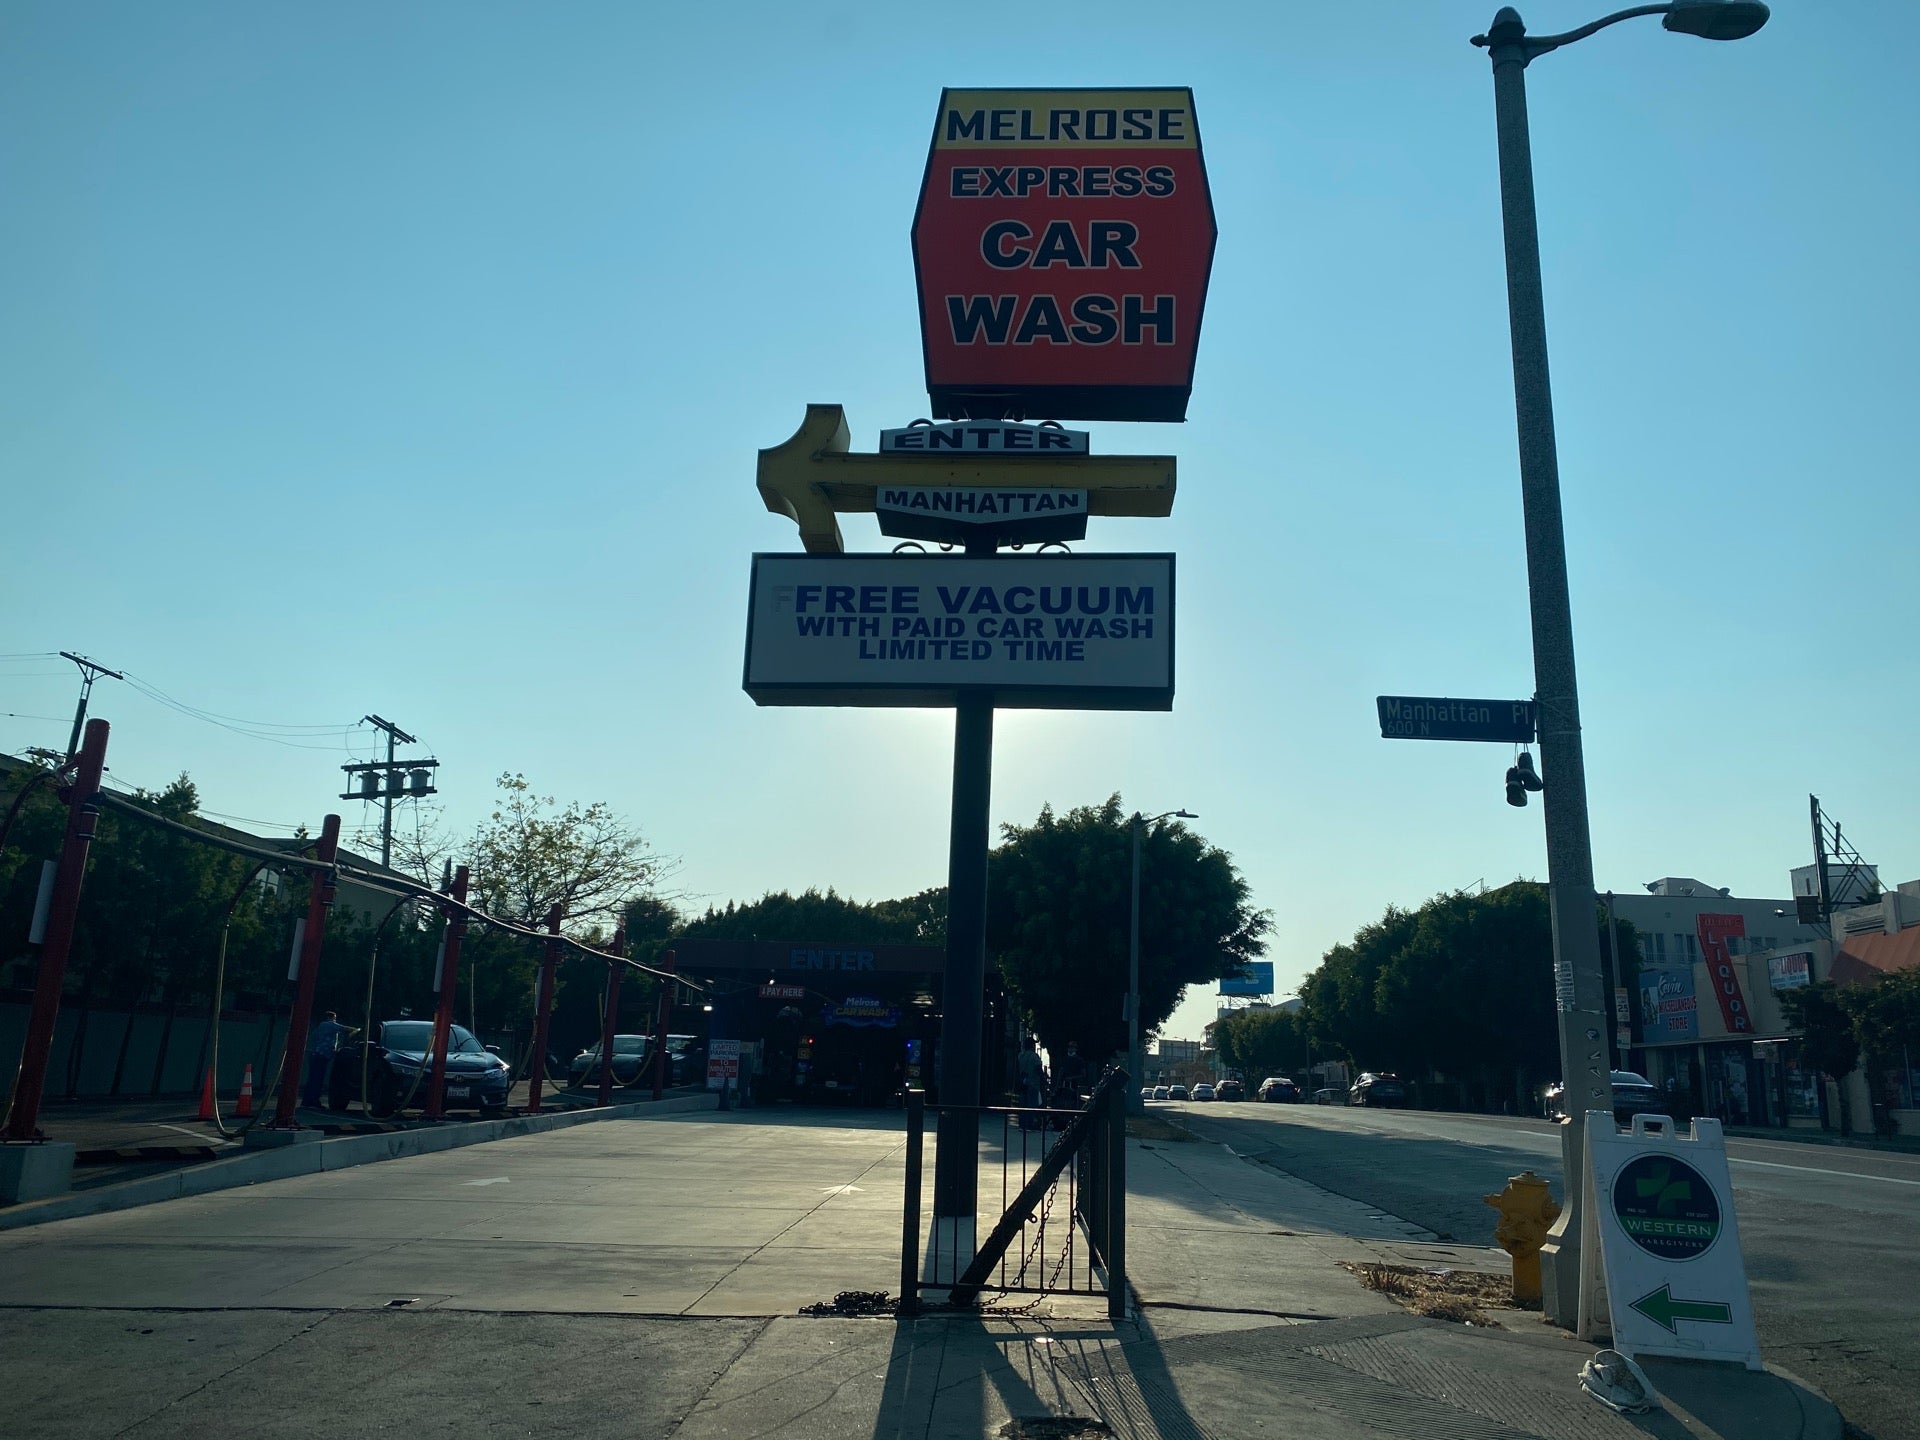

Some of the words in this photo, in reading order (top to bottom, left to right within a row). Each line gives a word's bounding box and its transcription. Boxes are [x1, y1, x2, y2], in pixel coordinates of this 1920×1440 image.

[945, 108, 1186, 142] MELROSE
[949, 165, 1177, 198] EXPRESS
[979, 219, 1143, 270] CAR
[945, 294, 1177, 346] WASH
[893, 427, 1074, 449] ENTER
[884, 490, 1079, 514] MANHATTAN
[795, 585, 920, 614] FREE
[936, 585, 1155, 615] VACUUM
[796, 616, 880, 637] WITH
[891, 617, 967, 638] PAID
[976, 617, 1044, 639] CAR
[1055, 617, 1154, 639] WASH
[858, 640, 993, 661] LIMITED
[1003, 640, 1085, 662] TIME
[1386, 699, 1491, 724] Manhattan
[1511, 703, 1530, 725] Pl
[1386, 720, 1414, 735] 600
[1420, 722, 1431, 736] N
[789, 948, 875, 971] ENTER
[1706, 930, 1746, 1030] LIQUOR
[766, 987, 781, 997] PAY
[782, 988, 804, 997] HERE
[845, 997, 881, 1008] Melrose
[835, 1007, 857, 1017] CAR
[858, 1008, 890, 1017] WASH
[1669, 1016, 1688, 1031] STORE
[1626, 1219, 1712, 1236] WESTERN
[1639, 1237, 1705, 1248] CAREGIVERS
